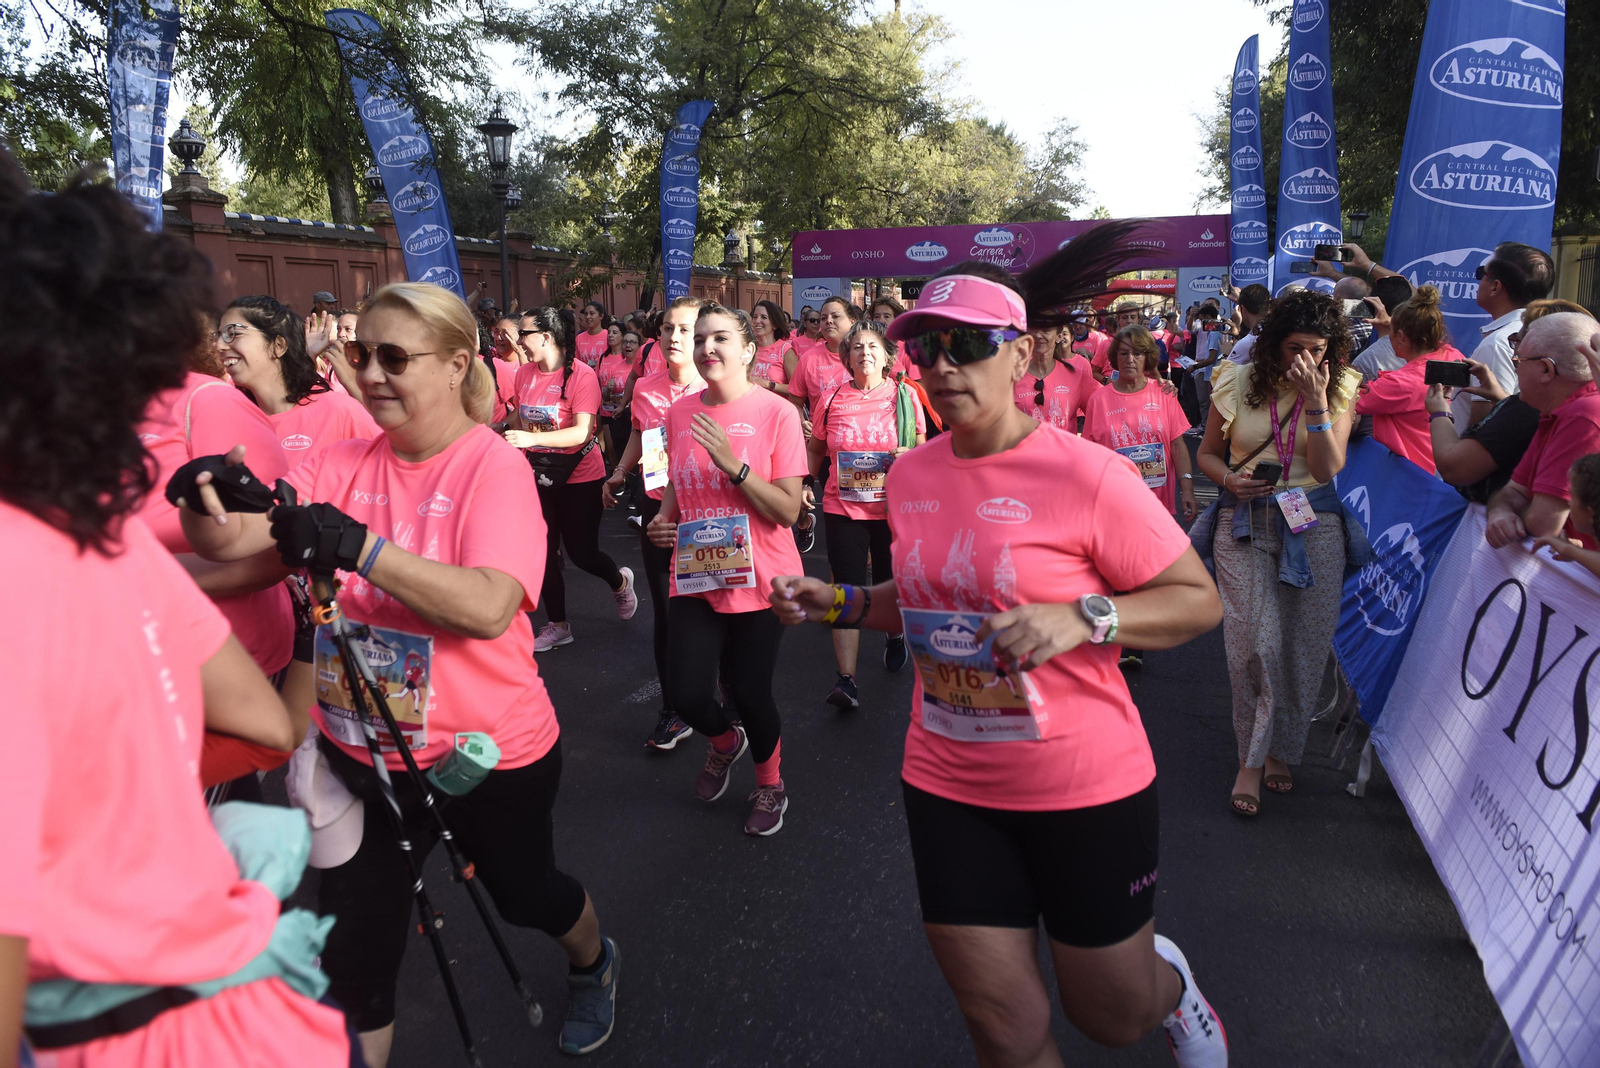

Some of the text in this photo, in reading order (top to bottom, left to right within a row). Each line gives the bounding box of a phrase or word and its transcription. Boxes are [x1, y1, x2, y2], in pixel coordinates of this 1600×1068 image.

[1468, 57, 1519, 69] CENTRAL
[1439, 57, 1562, 104] ASTURIANA
[1447, 162, 1551, 181] CENTRAL LECHERA
[1419, 163, 1552, 201] ASTURIANA
[1287, 181, 1336, 195] ASTURIANA
[1188, 240, 1226, 249] Santander
[851, 250, 885, 259] OYSHO
[908, 248, 946, 257] ASTURIANA
[970, 245, 1004, 256] Carrera
[800, 253, 832, 262] Santander
[1427, 269, 1477, 278] CENTRAL
[803, 290, 832, 298] ASTURIANA
[1106, 407, 1127, 416] OYSHO
[854, 471, 877, 481] 016
[900, 500, 940, 514] OYSHO
[980, 505, 1027, 520] ASTURIANA
[694, 531, 725, 541] ASTURIANA
[695, 546, 727, 562] 016
[703, 562, 721, 571] 2513
[683, 581, 707, 590] OYSHO
[937, 662, 982, 690] 016
[1461, 577, 1600, 834] OYS
[984, 724, 1026, 733] Santander
[1470, 774, 1587, 964] WWW.OYSHO.COM
